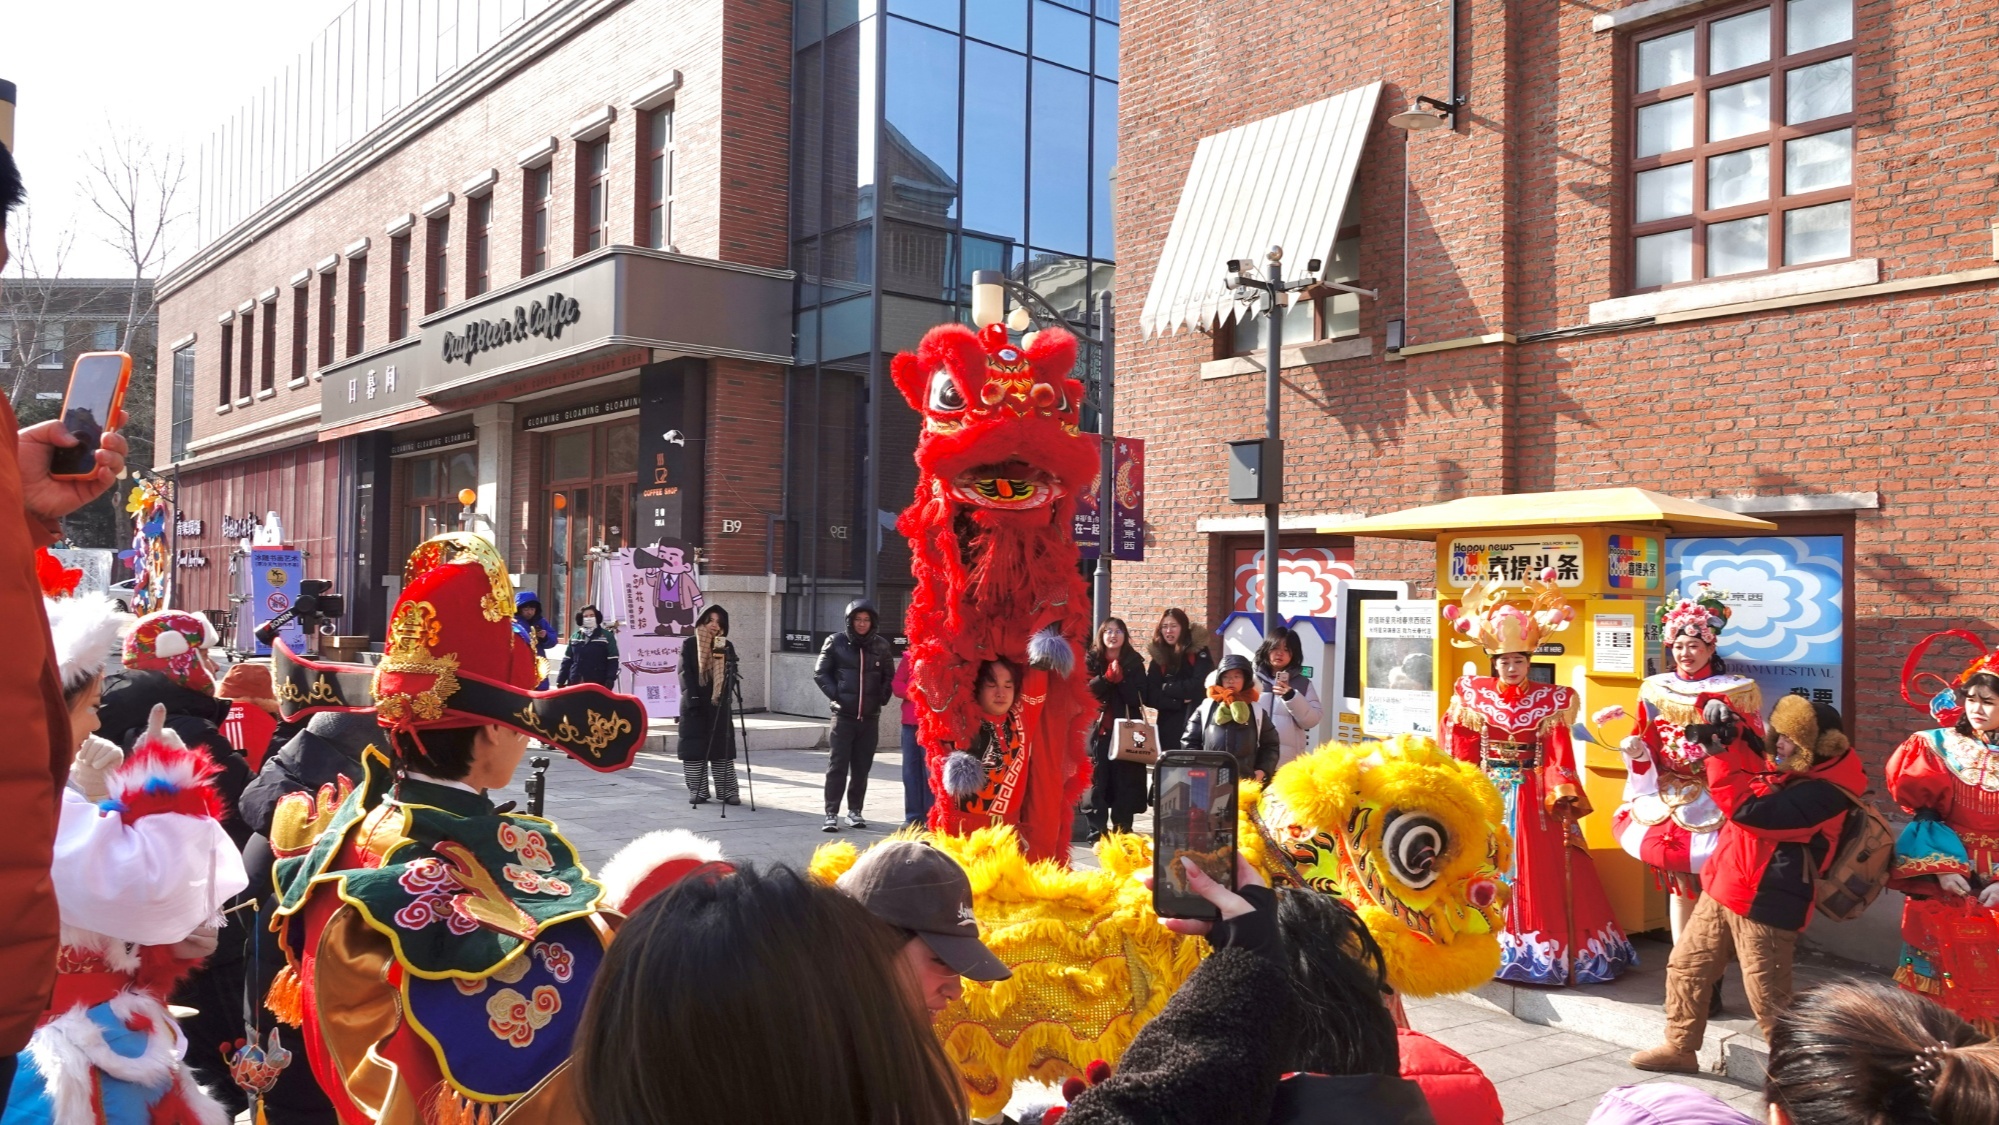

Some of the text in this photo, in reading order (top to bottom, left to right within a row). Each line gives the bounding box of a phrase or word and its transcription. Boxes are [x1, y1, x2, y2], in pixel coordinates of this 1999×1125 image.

[442, 292, 581, 365] Craft Beer & Coffee
[622, 353, 642, 366] BEER
[528, 413, 560, 427] GLOAMING
[565, 405, 600, 420] GLOAMING
[722, 519, 742, 534] B9
[1074, 523, 1100, 535] 在一起
[1122, 518, 1136, 550] 春京西
[1454, 543, 1515, 555] Happy news
[270, 610, 293, 630] RONIN
[1726, 663, 1834, 679] DRAMA FESTIVAL
